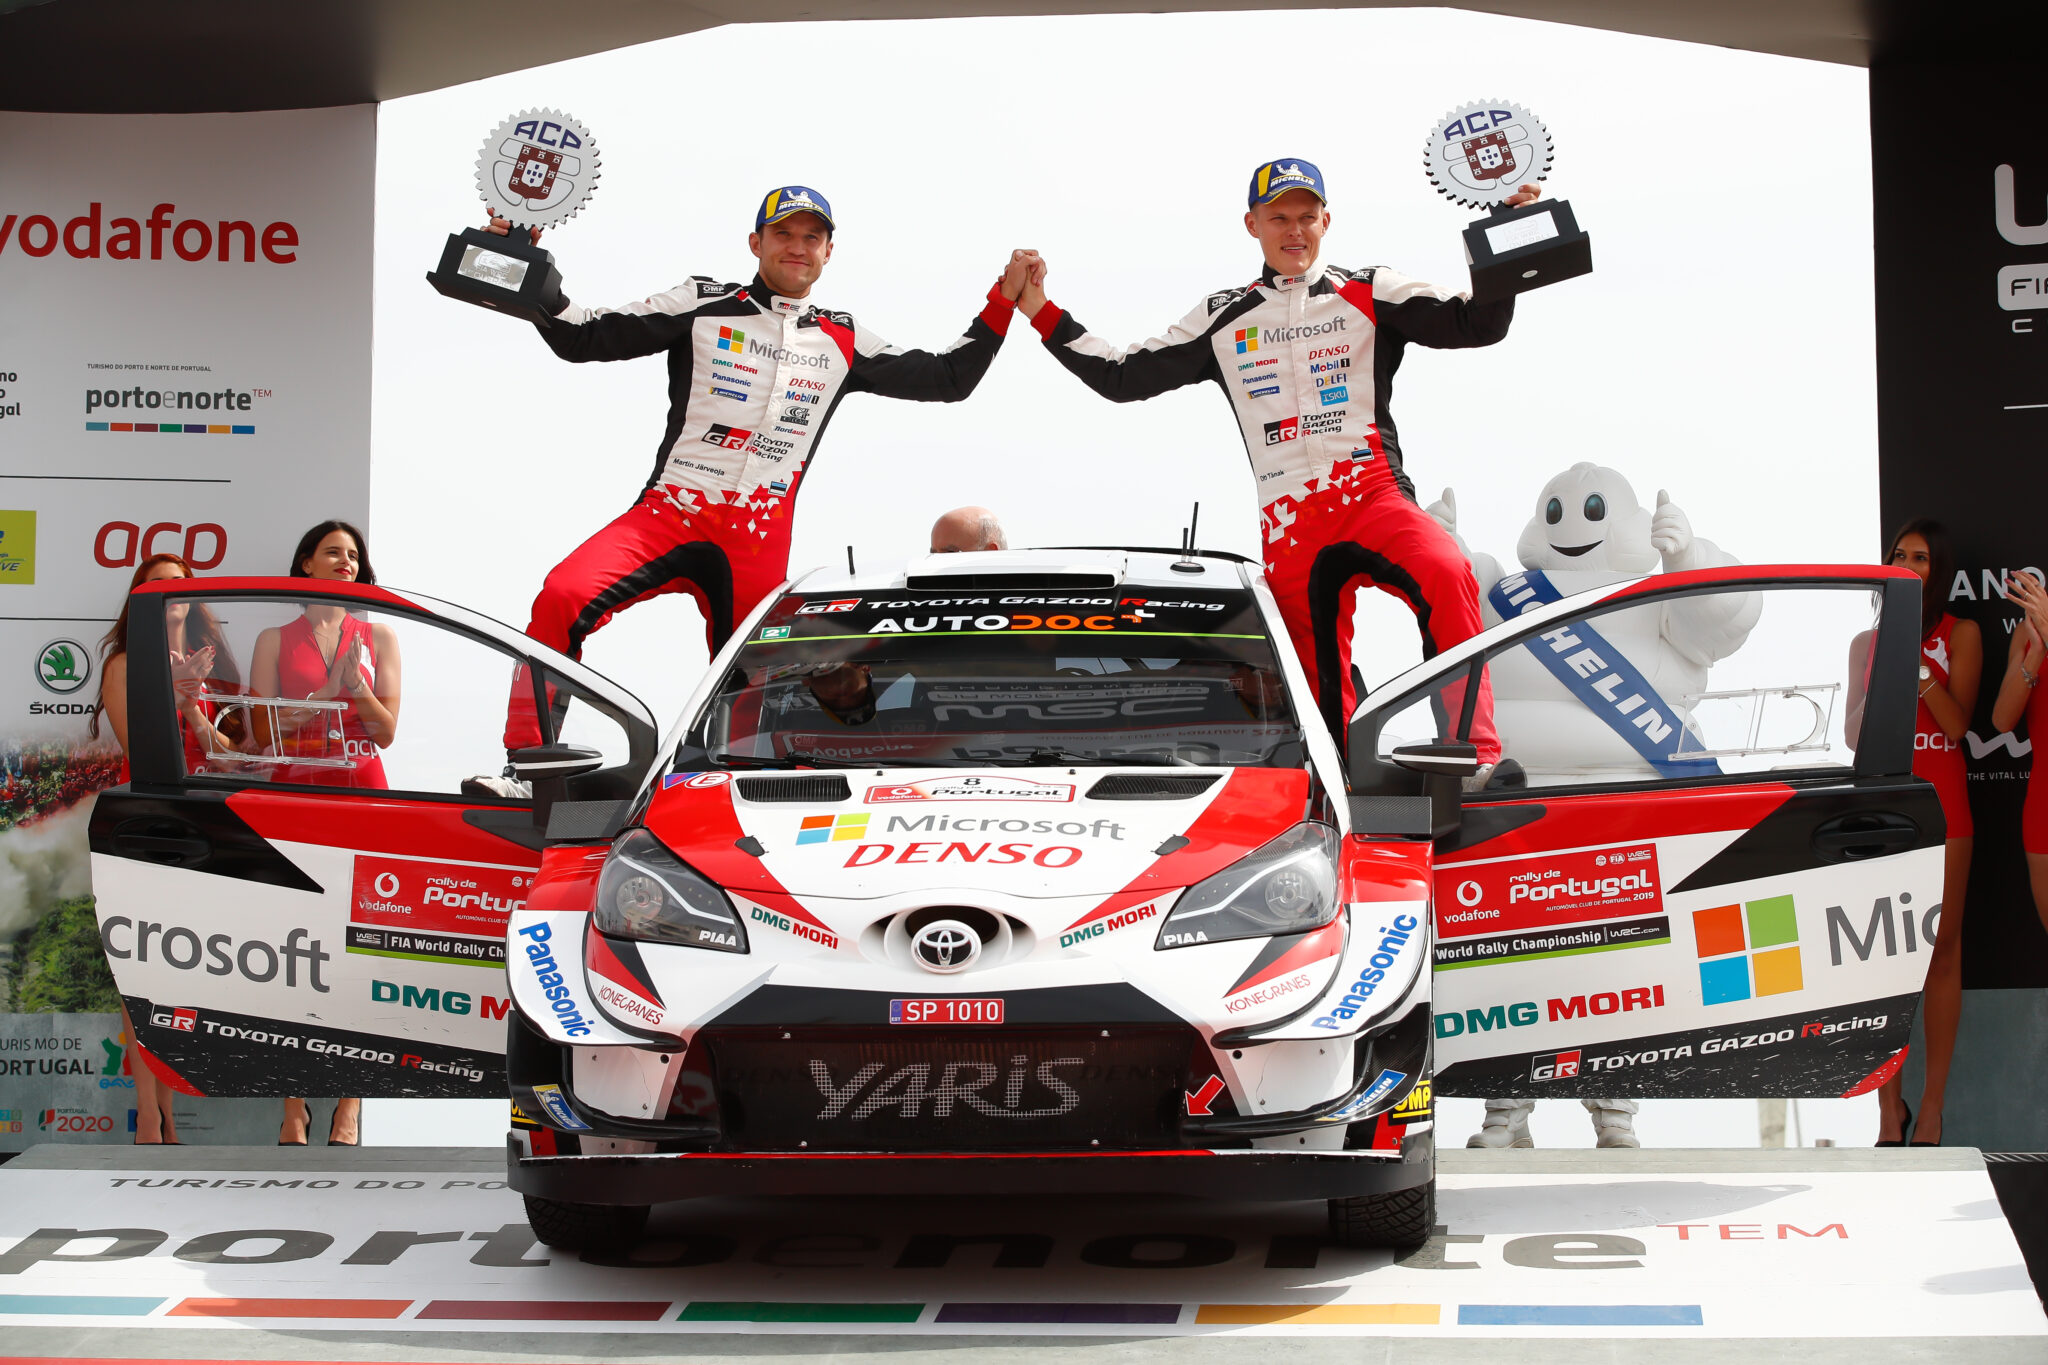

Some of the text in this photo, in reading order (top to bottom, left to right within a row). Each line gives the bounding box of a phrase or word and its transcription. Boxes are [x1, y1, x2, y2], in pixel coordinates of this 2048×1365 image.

[1444, 110, 1512, 141] ACP
[514, 121, 581, 149] ACP
[1263, 316, 1346, 344] Microsoft
[749, 339, 830, 370] Microsoft
[1309, 344, 1350, 360] DENSO
[712, 358, 758, 375] DMG MORI
[1238, 358, 1278, 371] DMG MORI
[1310, 360, 1339, 374] Mobil
[712, 372, 751, 387] Panasonic
[788, 378, 826, 391] DENSO
[1243, 373, 1277, 385] Panasonic
[1316, 373, 1347, 387] DELFI
[86, 386, 272, 414] portoenorte TEM
[785, 391, 811, 404] Mobil
[1302, 410, 1346, 422] TOYOTA
[1302, 418, 1342, 428] GAZOO
[1266, 426, 1297, 444] GR
[1301, 426, 1342, 437] Racing
[702, 433, 747, 450] GR
[752, 440, 788, 455] GAZOO
[756, 433, 794, 448] TOYOTA
[745, 446, 783, 462] Racing
[673, 458, 725, 476] Martin Järveoja
[800, 596, 1225, 613] GR TOYOTA GAZOO Racing
[868, 615, 1116, 634] AUTODOC
[30, 701, 95, 715] ŠKODA
[346, 739, 379, 759] acp
[1914, 732, 1957, 752] acp
[963, 778, 981, 786] 8
[1967, 772, 1985, 780] THE
[1989, 771, 2015, 780] VITAL
[931, 789, 1062, 797] Portugal
[886, 815, 1126, 841] Microsoft
[843, 842, 1083, 868] DENSO
[426, 877, 477, 889] rally de
[1509, 870, 1561, 883] rally de
[1510, 869, 1653, 904] Portugal
[1633, 891, 1655, 901] 2019
[359, 901, 412, 915] vodafone
[1444, 908, 1500, 924] vodafone
[750, 907, 839, 950] DMG MORI
[1060, 903, 1157, 948] DMG MORI
[699, 930, 737, 946] PIAA
[1163, 931, 1208, 946] PIAA
[1436, 946, 1473, 960] World
[1477, 942, 1509, 955] Rally
[1513, 931, 1602, 951] Championship
[391, 936, 411, 948] FIA
[414, 938, 450, 953] World
[454, 944, 485, 958] Rally
[518, 921, 595, 1037] Panasonic
[1311, 913, 1418, 1031] Panasonic
[372, 979, 471, 1015] DMG
[1225, 974, 1311, 1014] KONECRANES
[599, 985, 664, 1025] KONECRANES
[907, 1001, 999, 1021] SP 1010
[1434, 984, 1665, 1039] DMG MORI
[64, 1038, 82, 1050] DE
[152, 1013, 484, 1083] GR TOYOTA GAZOO Racing
[1532, 1015, 1888, 1080] GR TOYOTA GAZOO Racing
[57, 1116, 114, 1132] 2020
[109, 1178, 340, 1190] TURISMO
[355, 1179, 426, 1190] DO
[1656, 1223, 1849, 1240] TEM
